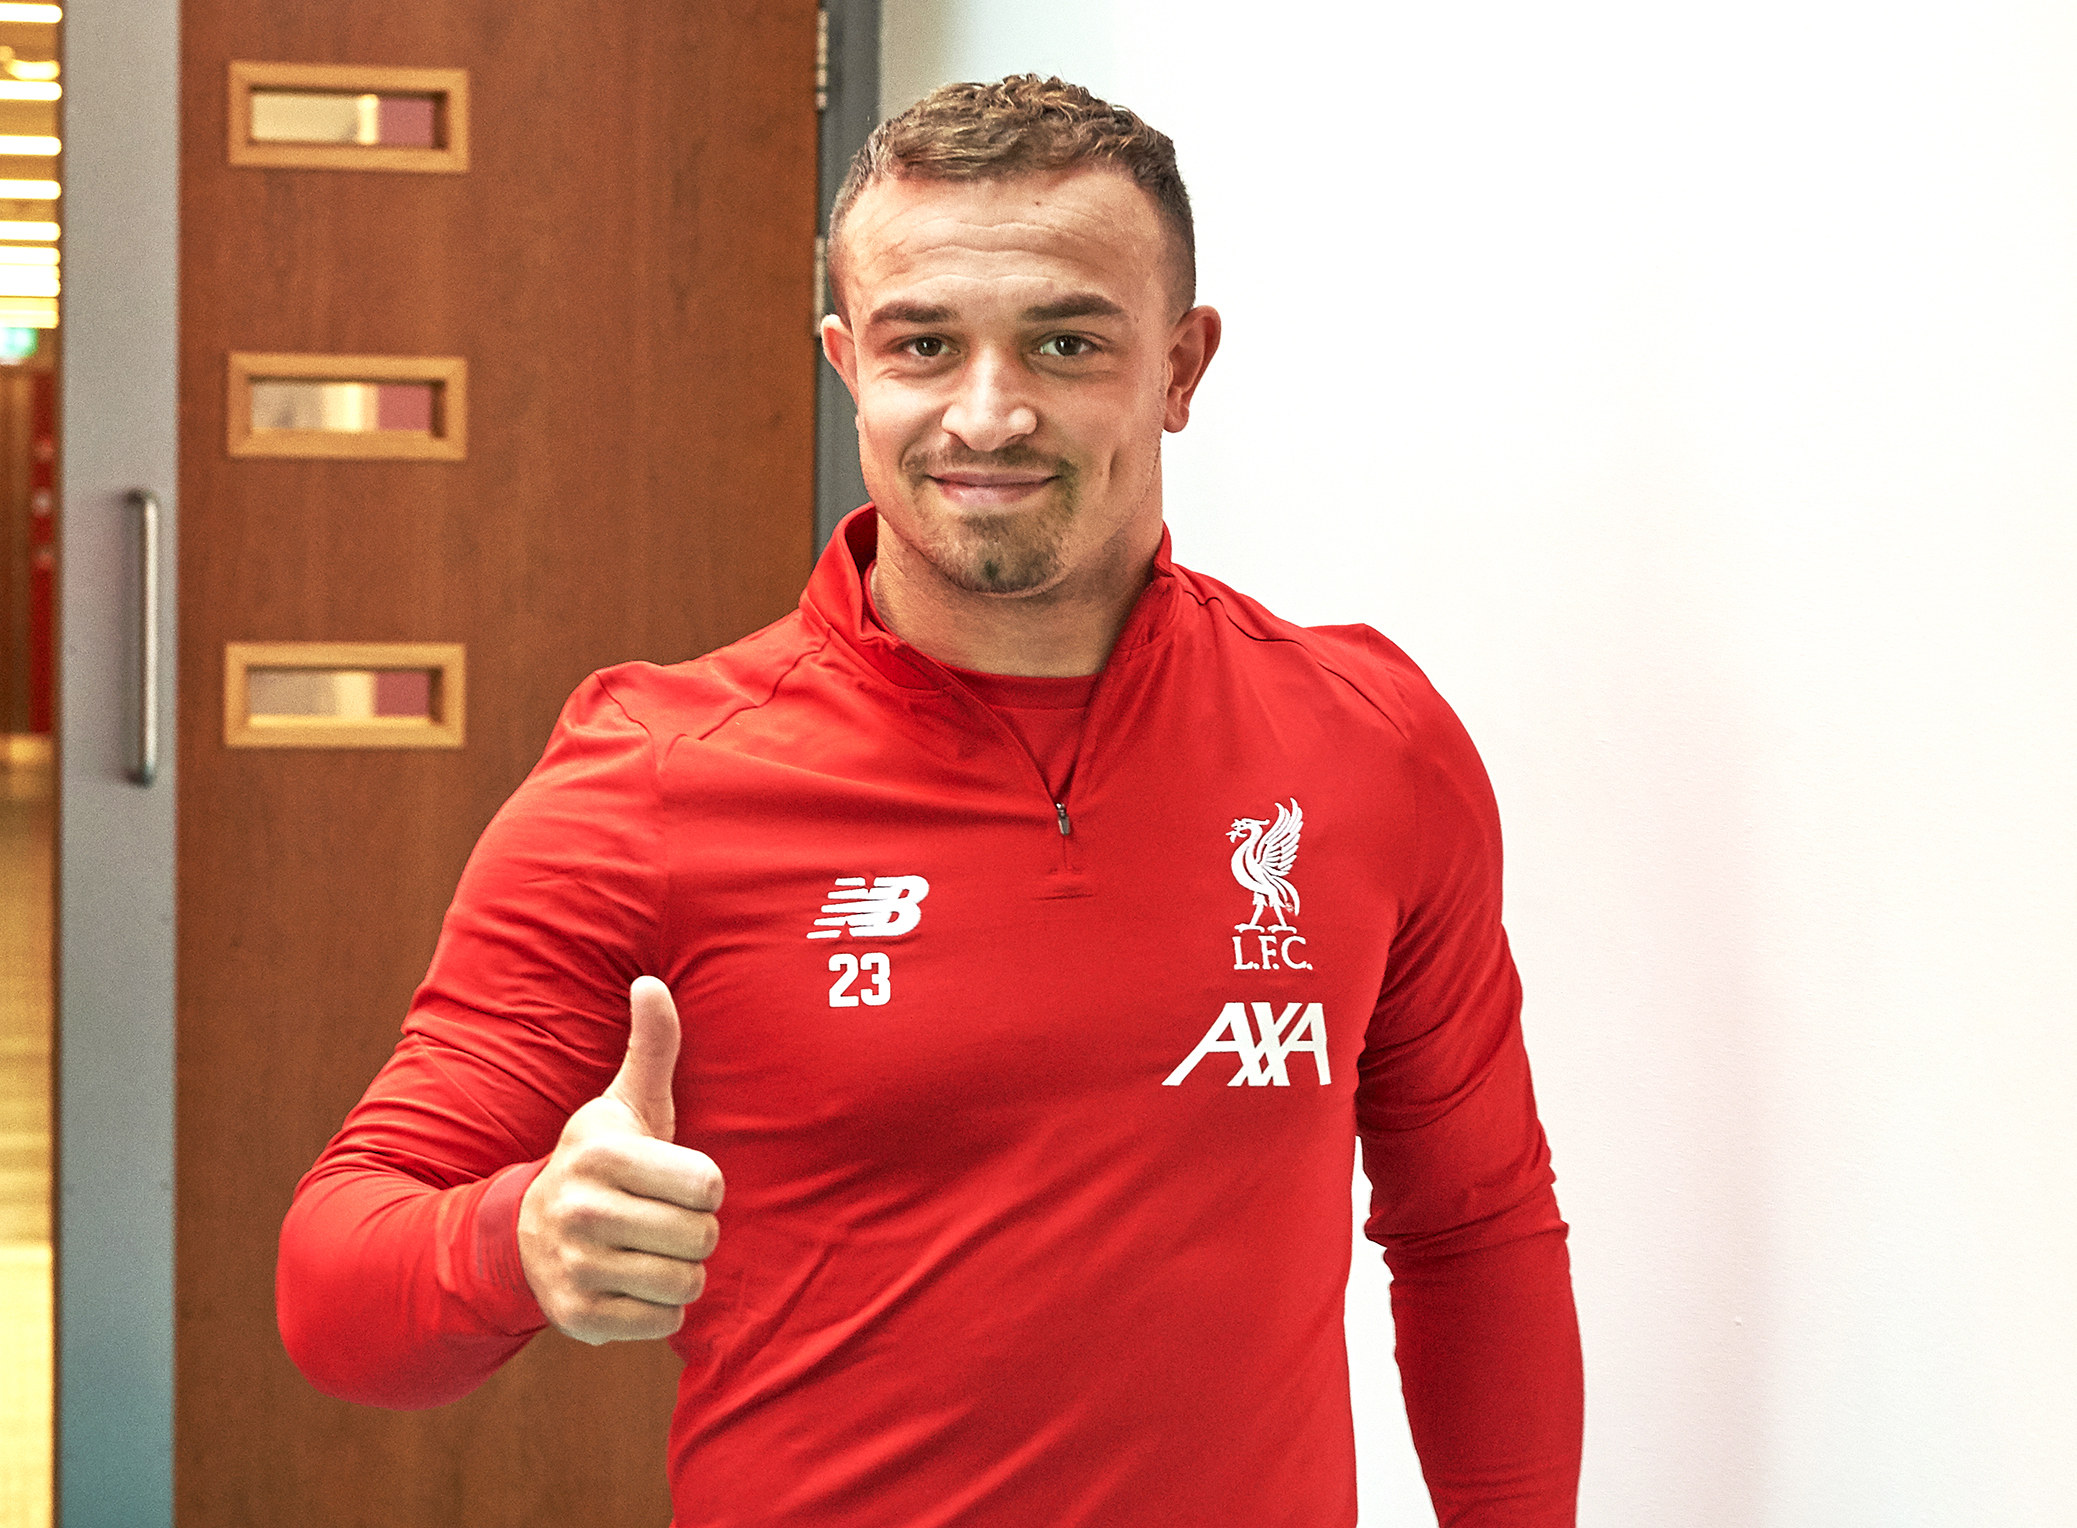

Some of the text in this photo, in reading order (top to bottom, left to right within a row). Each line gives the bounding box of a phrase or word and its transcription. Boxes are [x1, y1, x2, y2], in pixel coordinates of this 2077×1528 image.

[828, 952, 891, 1008] 23
[1232, 935, 1314, 971] L.F.C.
[1162, 1001, 1331, 1087] AXA
